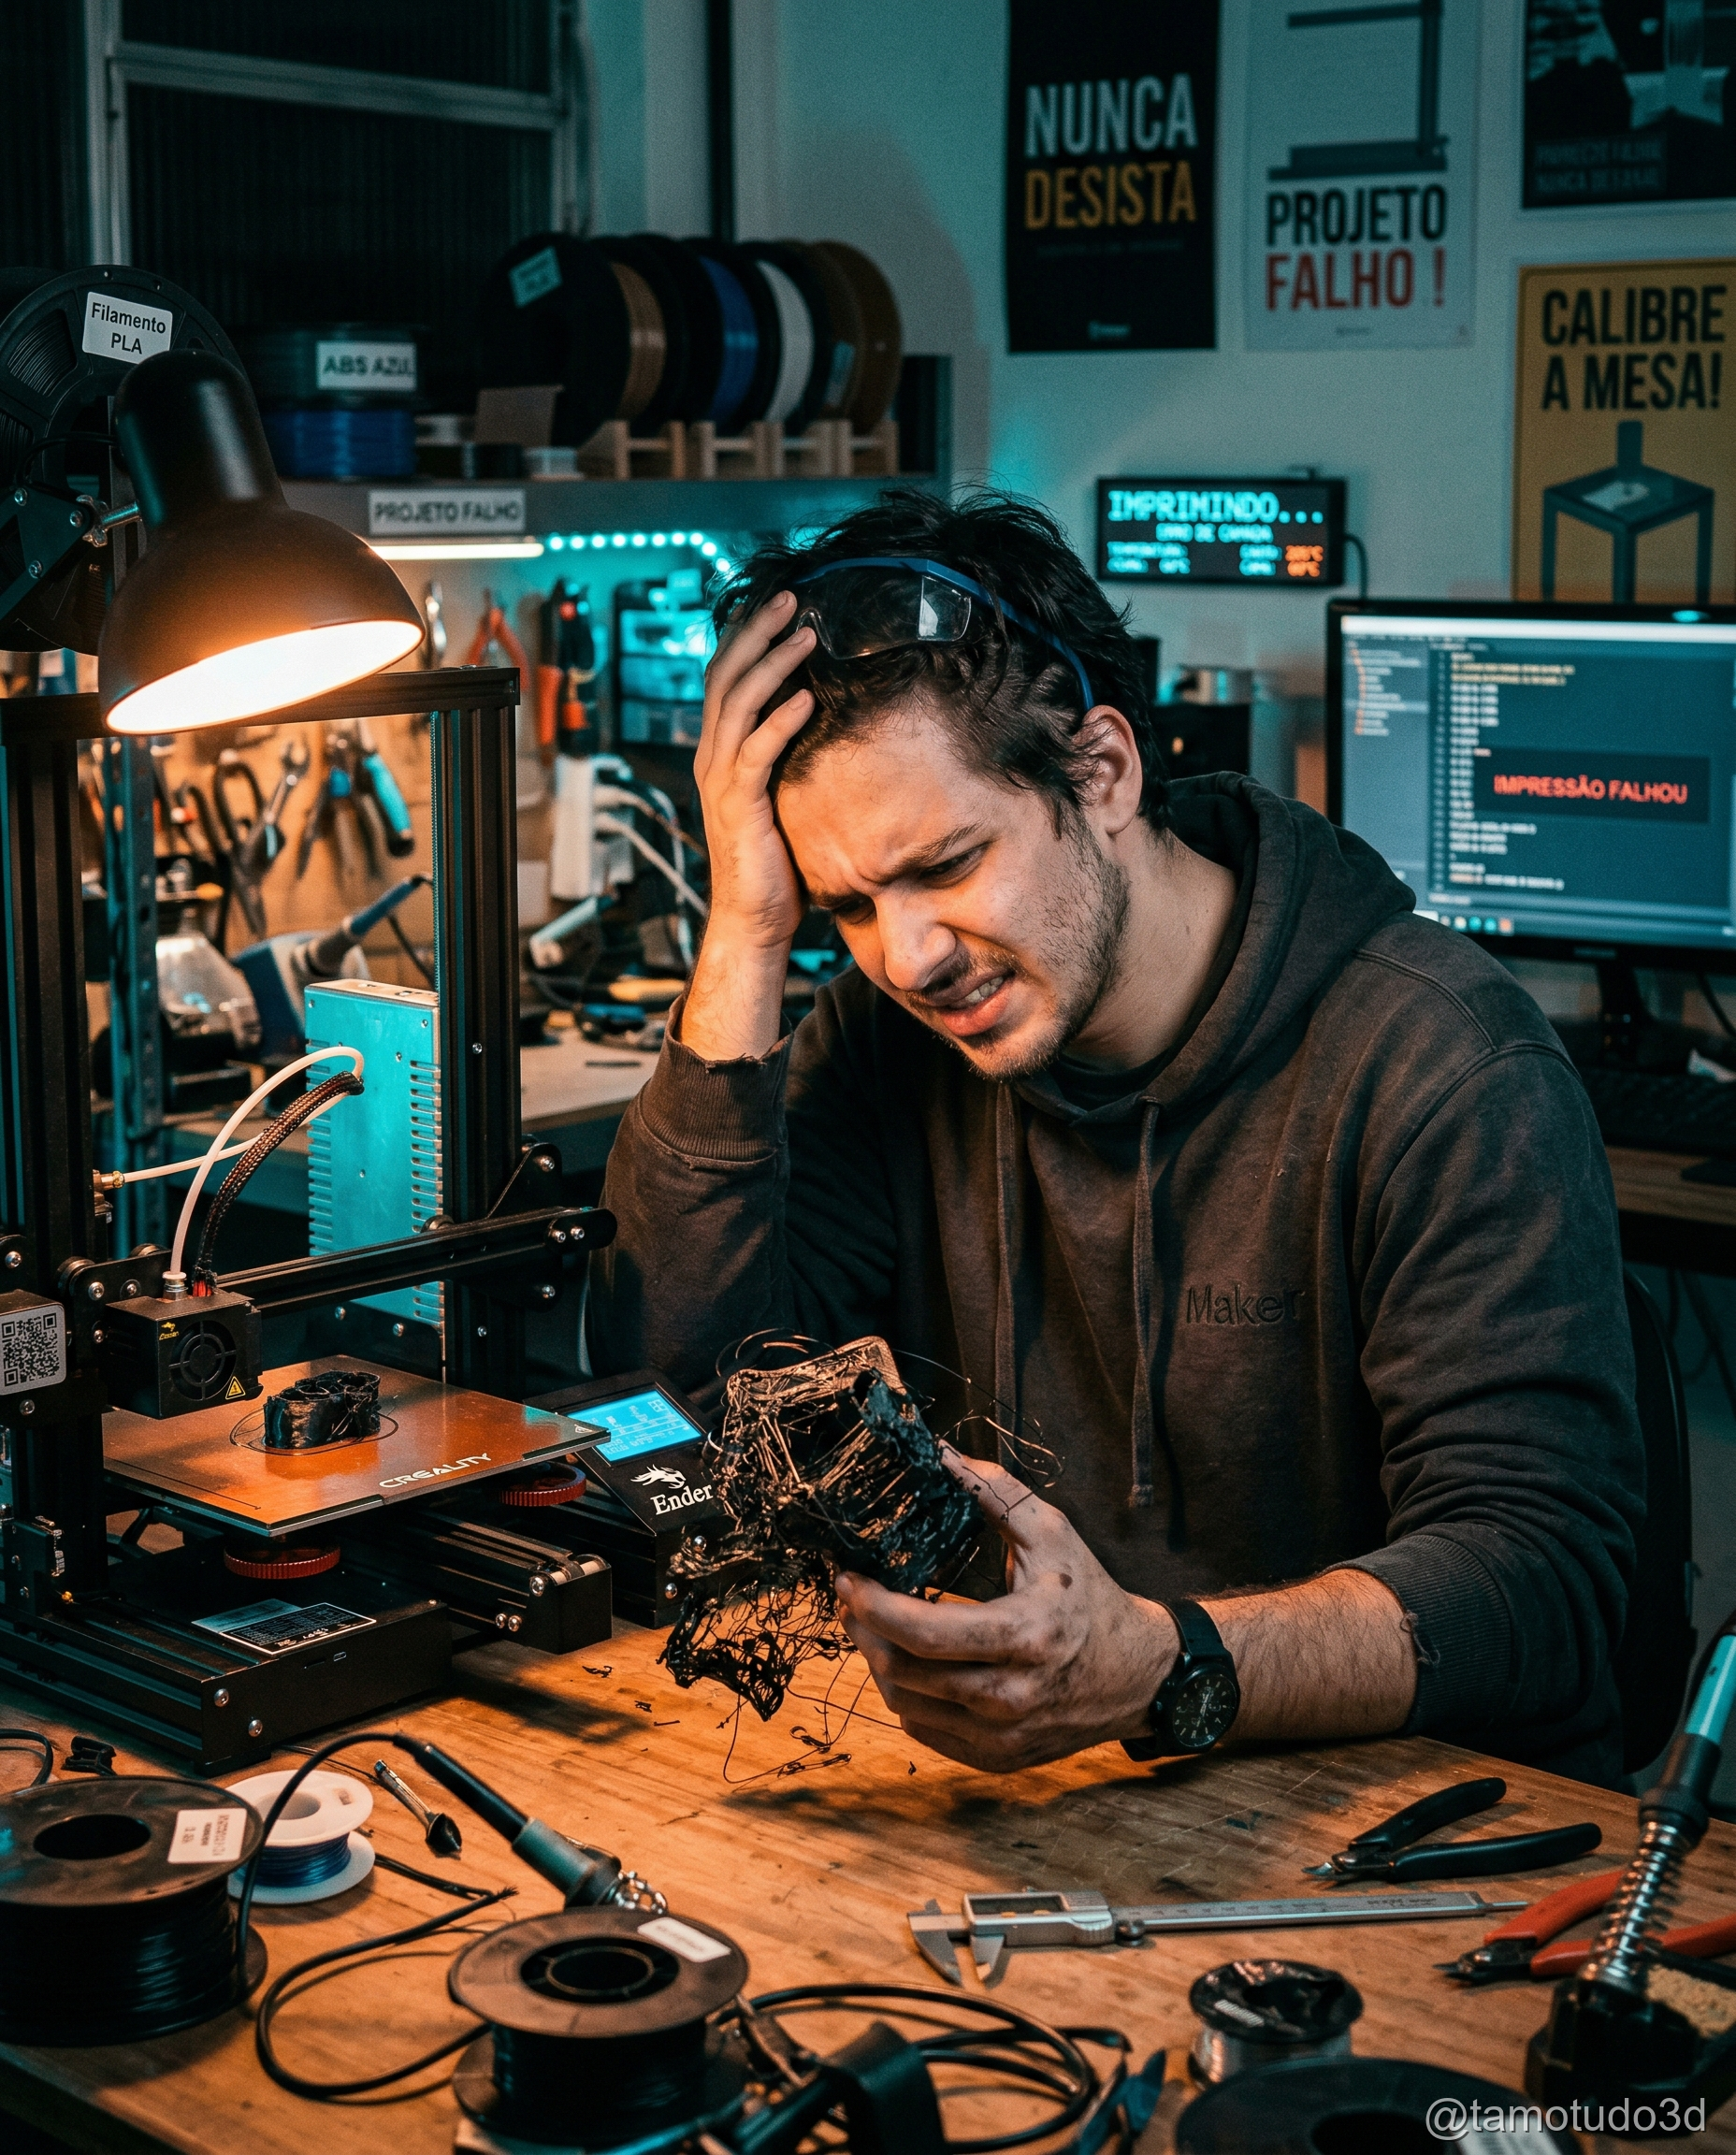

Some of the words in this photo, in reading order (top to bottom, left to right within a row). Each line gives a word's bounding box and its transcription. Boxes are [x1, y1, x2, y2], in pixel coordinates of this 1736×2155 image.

[1024, 72, 1199, 159] NUNCA
[1024, 160, 1197, 231] DESISTA
[1266, 183, 1448, 247] PROJETO
[1266, 247, 1415, 312] FALHO
[91, 301, 166, 334] Filamento
[1542, 284, 1727, 346] CALIBRE
[110, 332, 143, 355] PLA
[324, 354, 369, 376] ABS
[1541, 354, 1570, 412] A
[1583, 351, 1721, 412] MESA!
[374, 501, 458, 524] PROJETO
[1493, 774, 1606, 802] IMPRESSÃO
[1608, 779, 1688, 805] FALHOU
[1186, 1282, 1306, 1325] Maker
[378, 1453, 492, 1488] CREALITY
[650, 1484, 714, 1515] Ender
